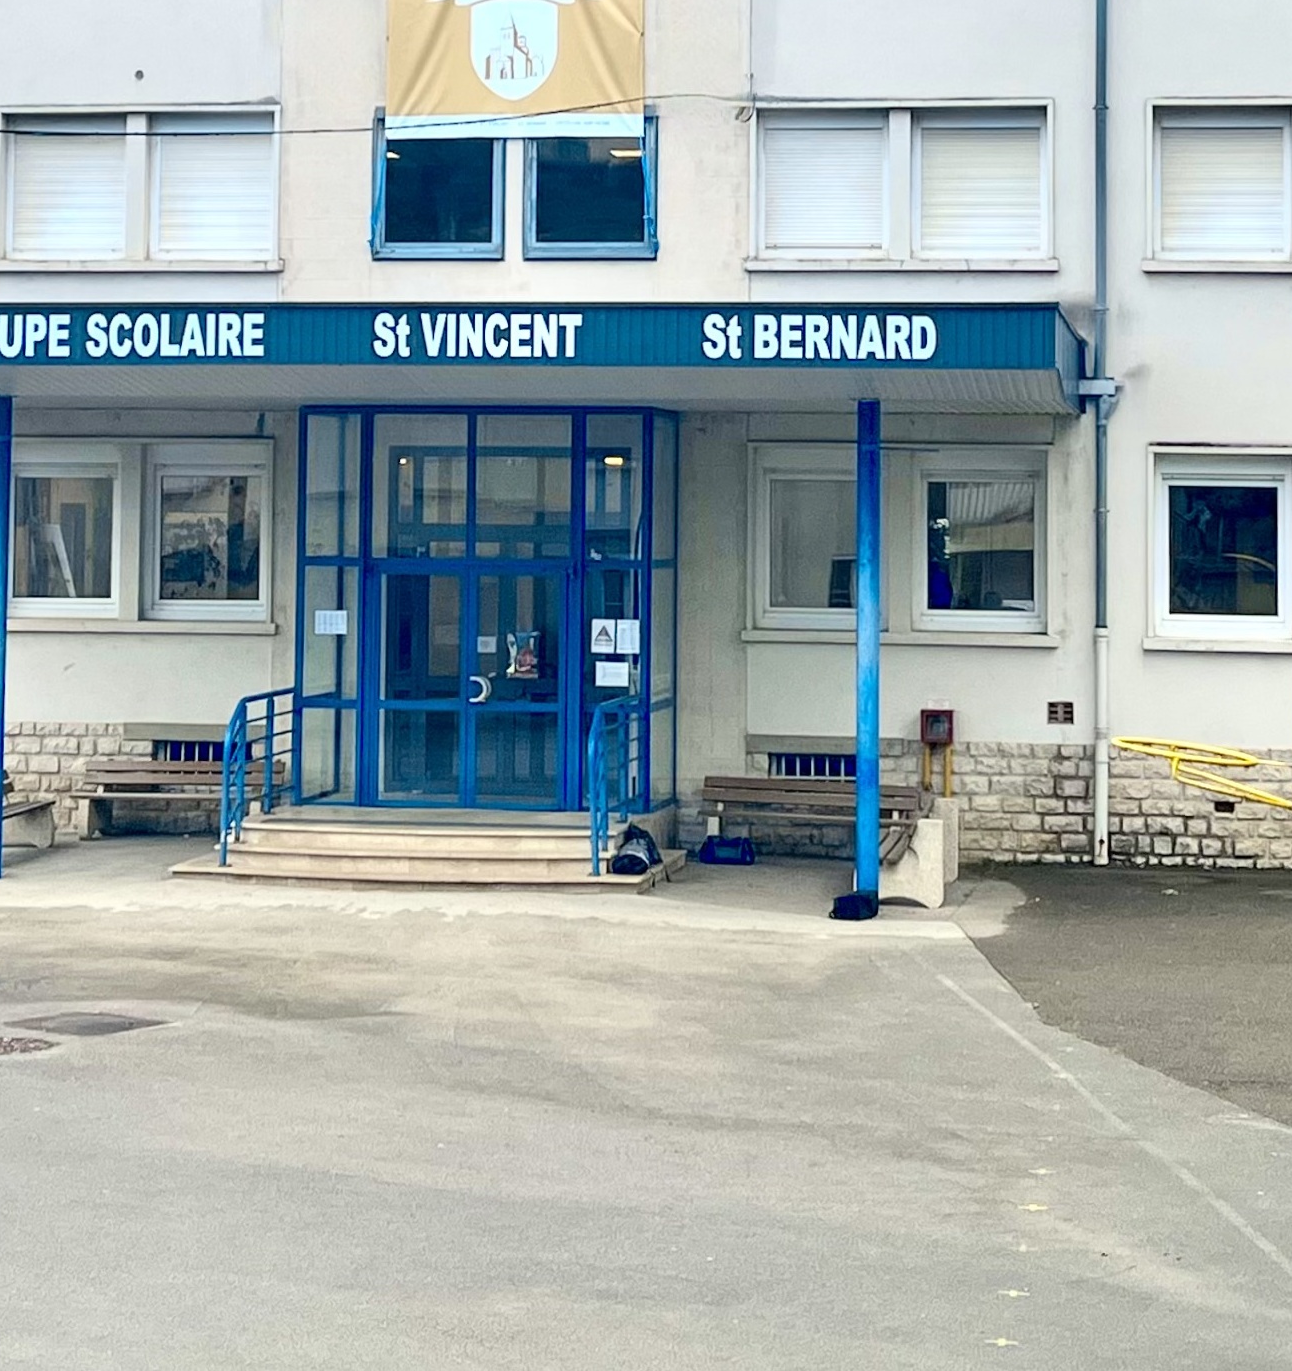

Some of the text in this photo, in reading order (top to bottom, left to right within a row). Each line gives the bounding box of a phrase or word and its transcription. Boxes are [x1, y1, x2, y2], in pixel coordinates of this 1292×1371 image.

[85, 312, 265, 358] SCOLAIRE
[372, 311, 411, 358] St
[420, 312, 584, 359] VINCENT
[701, 313, 743, 360] St
[753, 314, 937, 361] BERNARD
